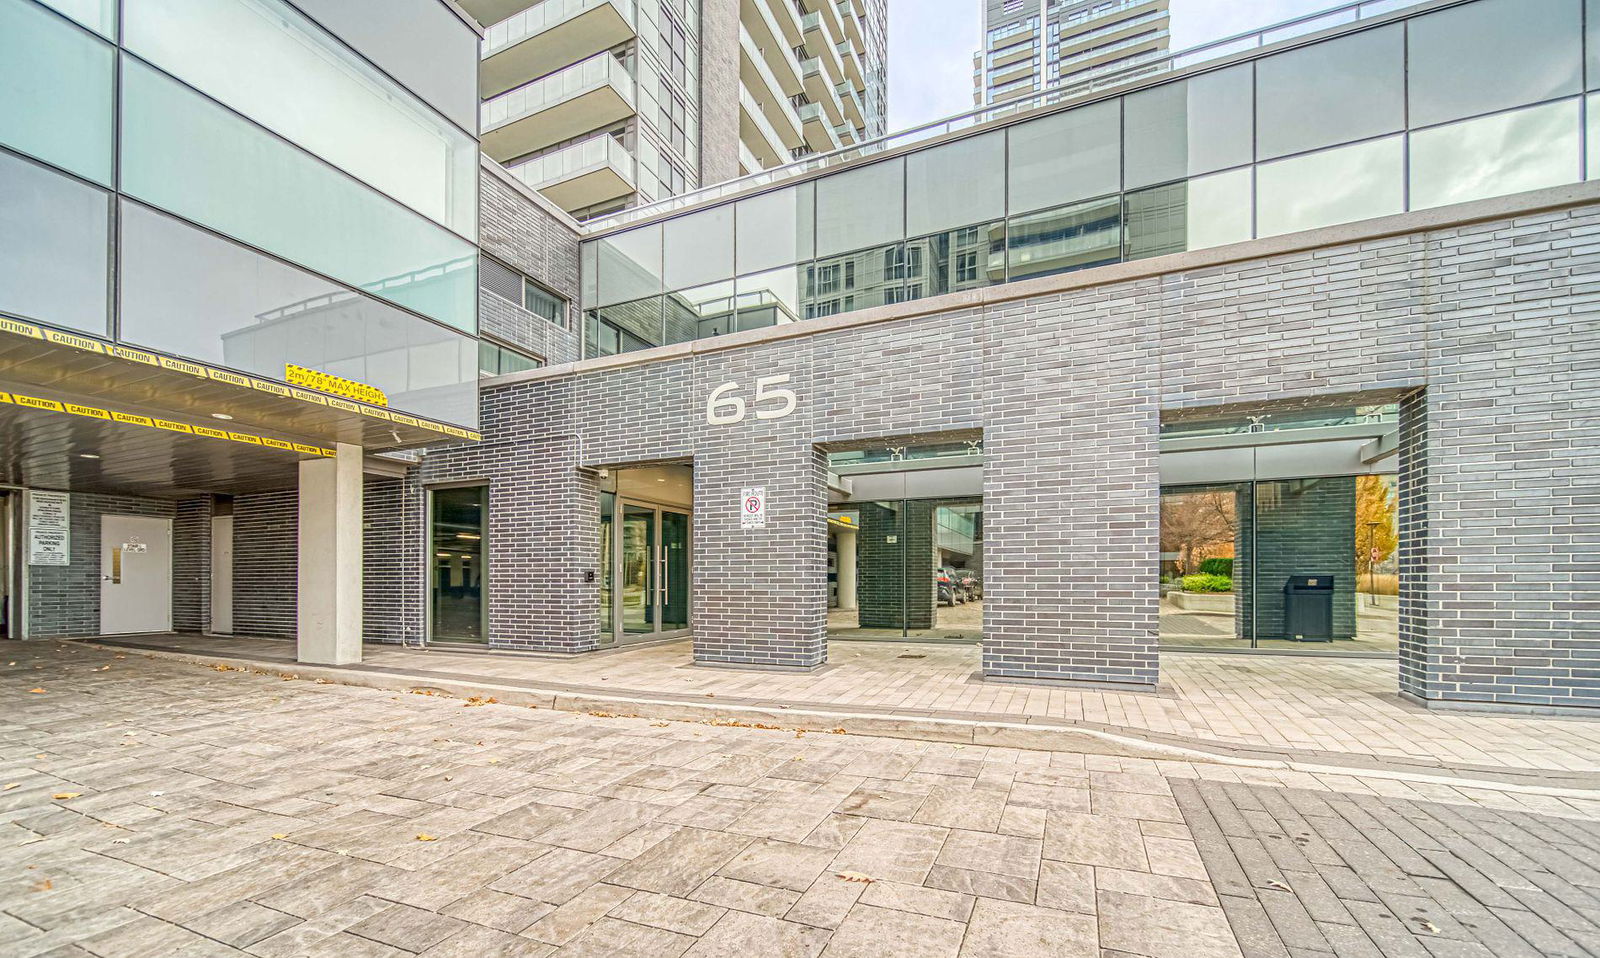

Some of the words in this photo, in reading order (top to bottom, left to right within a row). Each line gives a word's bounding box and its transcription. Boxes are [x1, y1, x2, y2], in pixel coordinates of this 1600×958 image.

[1, 320, 33, 335] UTION
[53, 333, 95, 350] CAUTION
[113, 347, 151, 363] CAUTION
[165, 360, 200, 374] CAUTION
[213, 371, 245, 385] CAUTION
[256, 382, 285, 395] CAUTION
[295, 391, 322, 403] CAUTION
[331, 399, 355, 411] CAUTION
[364, 407, 386, 418] CAUTION
[328, 380, 351, 392] MAX
[20, 397, 56, 409] CAUTION
[70, 405, 104, 417] CAUTION
[117, 413, 147, 424] CAUTION
[159, 420, 187, 431] CAUTION
[197, 428, 223, 437] CAUTION
[707, 373, 797, 425] 65
